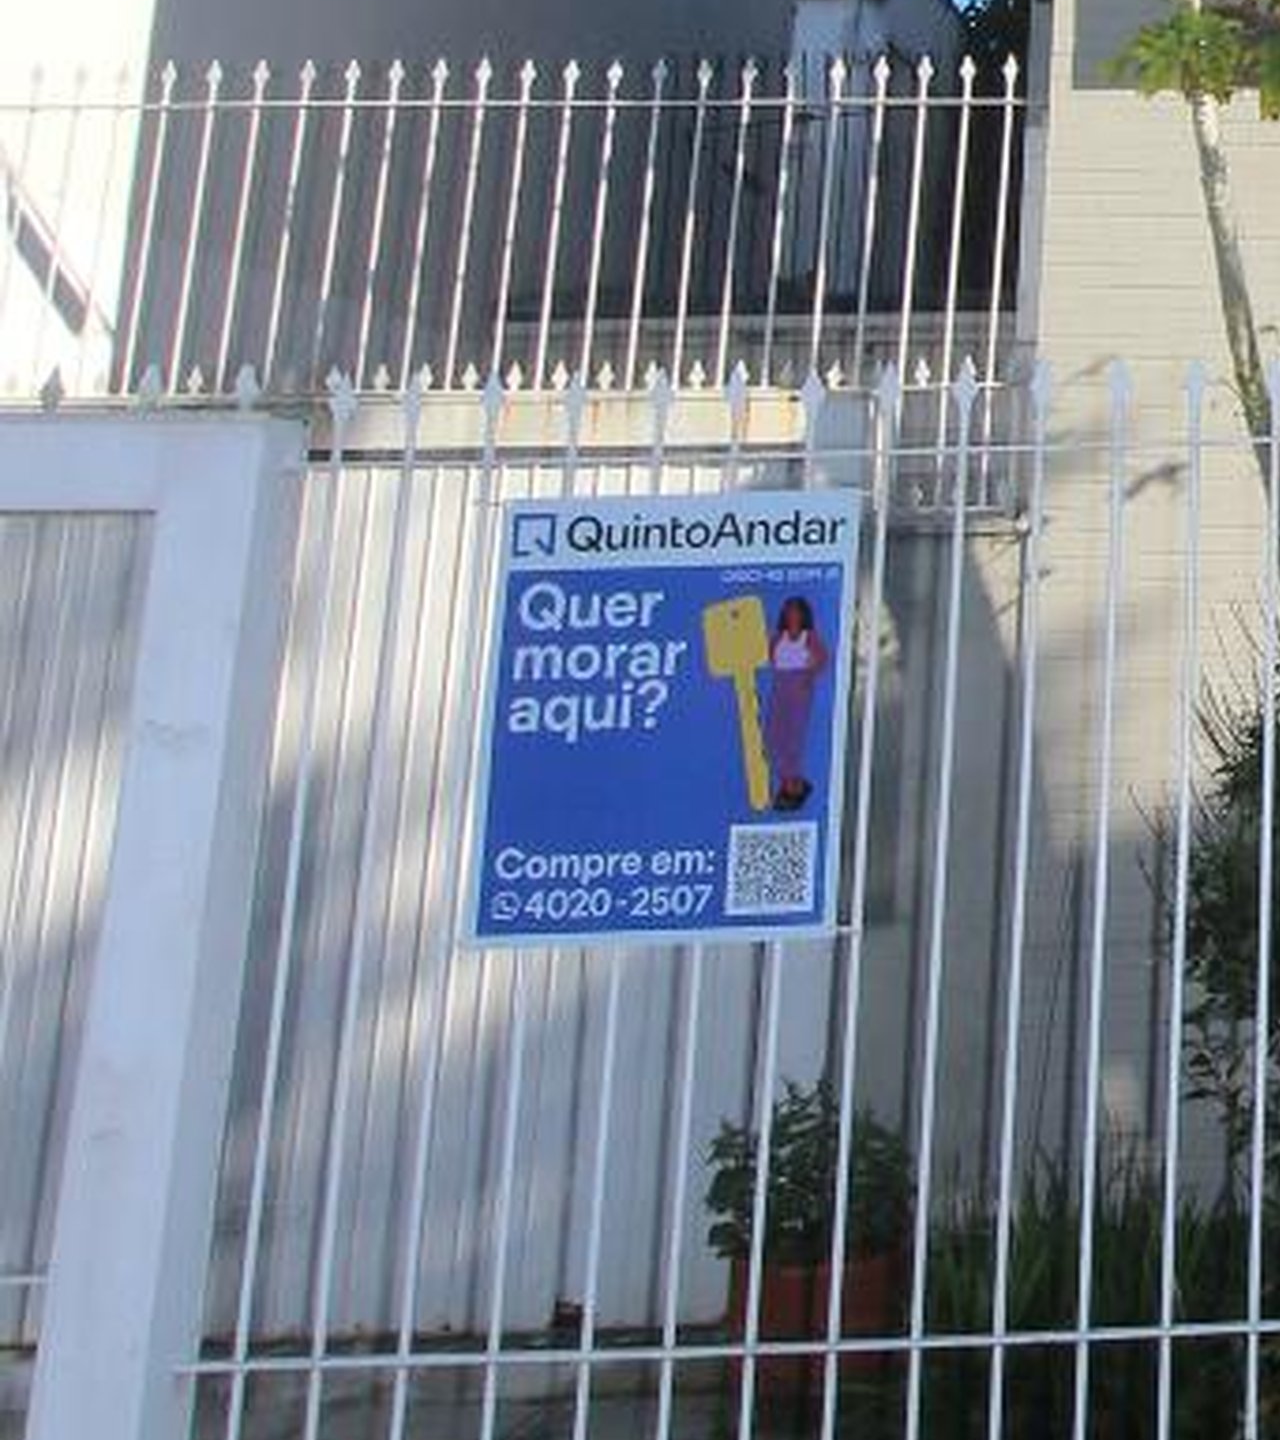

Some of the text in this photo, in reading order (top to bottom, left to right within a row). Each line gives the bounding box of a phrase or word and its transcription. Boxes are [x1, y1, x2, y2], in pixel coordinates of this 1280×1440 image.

[566, 510, 846, 553] QuintoAndar
[519, 581, 665, 632] Quer
[512, 640, 688, 681] morar
[508, 679, 669, 744] aqui?
[494, 846, 716, 886] Compre em:
